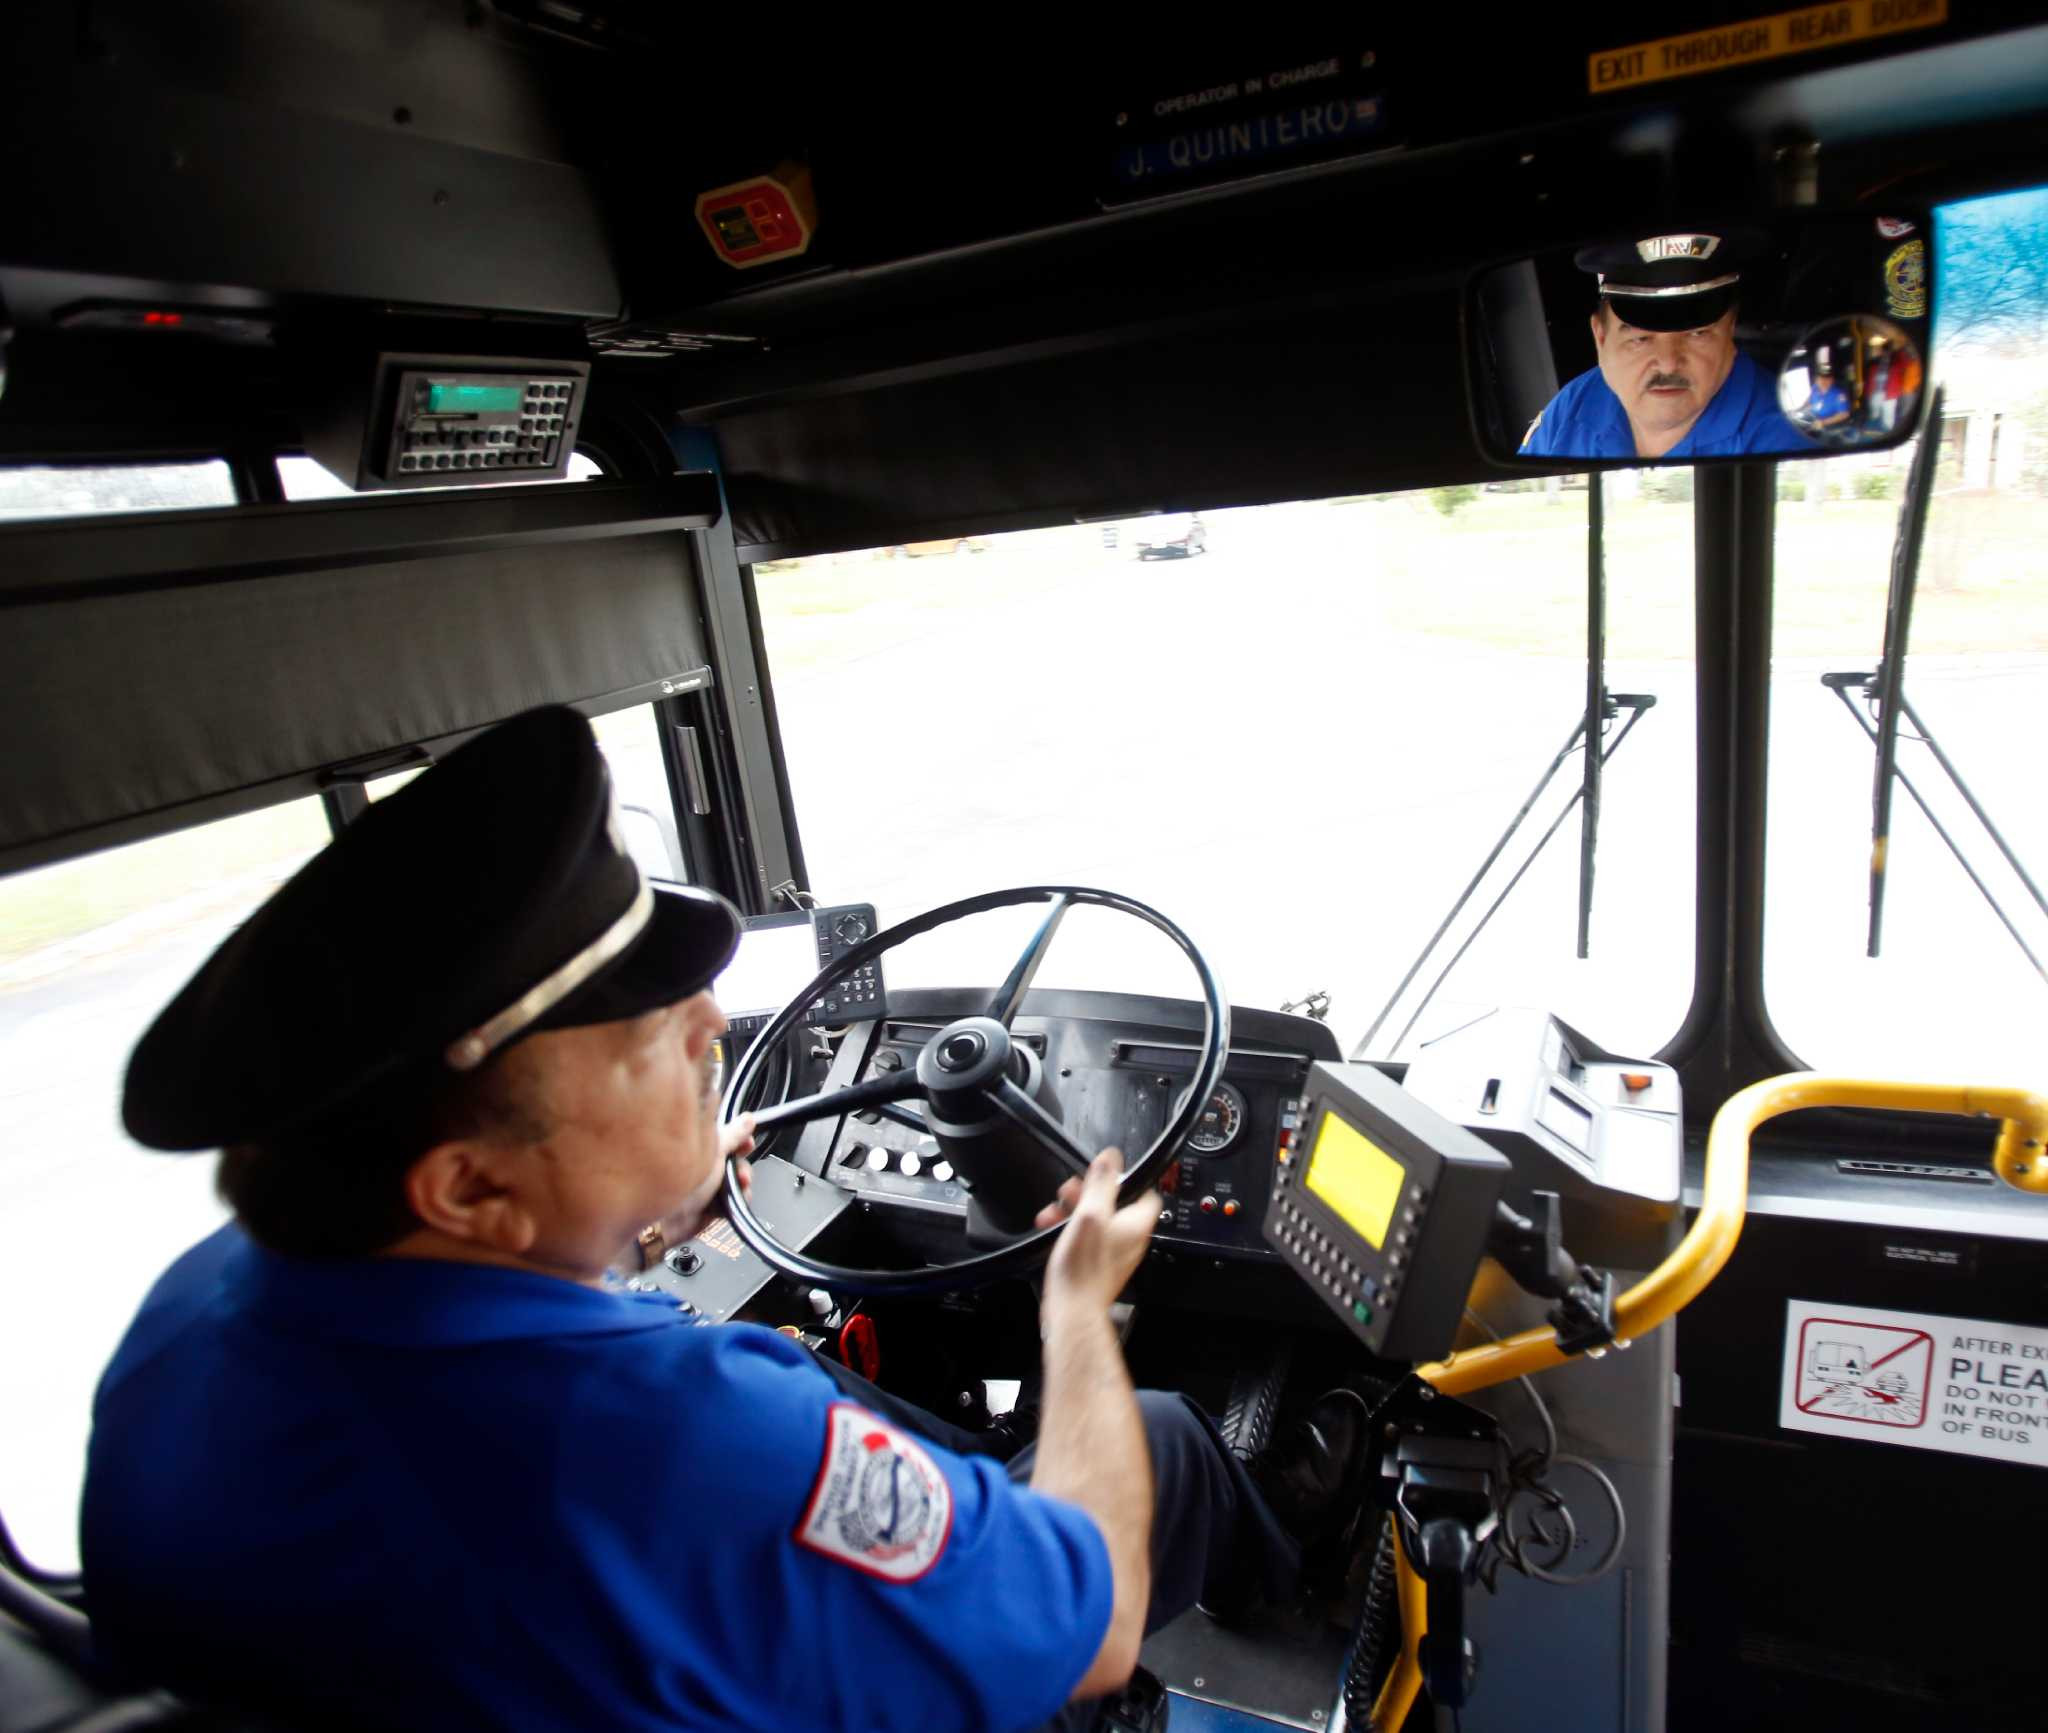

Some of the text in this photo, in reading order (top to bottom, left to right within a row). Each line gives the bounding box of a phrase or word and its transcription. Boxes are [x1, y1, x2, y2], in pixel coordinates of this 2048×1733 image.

[1596, 49, 1647, 84] EXIT
[1661, 24, 1769, 68] THROUGH
[1786, 7, 1851, 43] REAR
[1154, 56, 1340, 118] OPERATOR IN CHARGE
[1127, 98, 1349, 178] J. QUINTERO
[1953, 1337, 2012, 1355] AFTER
[1950, 1357, 2048, 1391] PLEA
[1943, 1402, 1966, 1417] IN
[1946, 1384, 1980, 1401] DO
[1987, 1391, 2040, 1409] NOT
[1941, 1420, 2031, 1445] OF BUS
